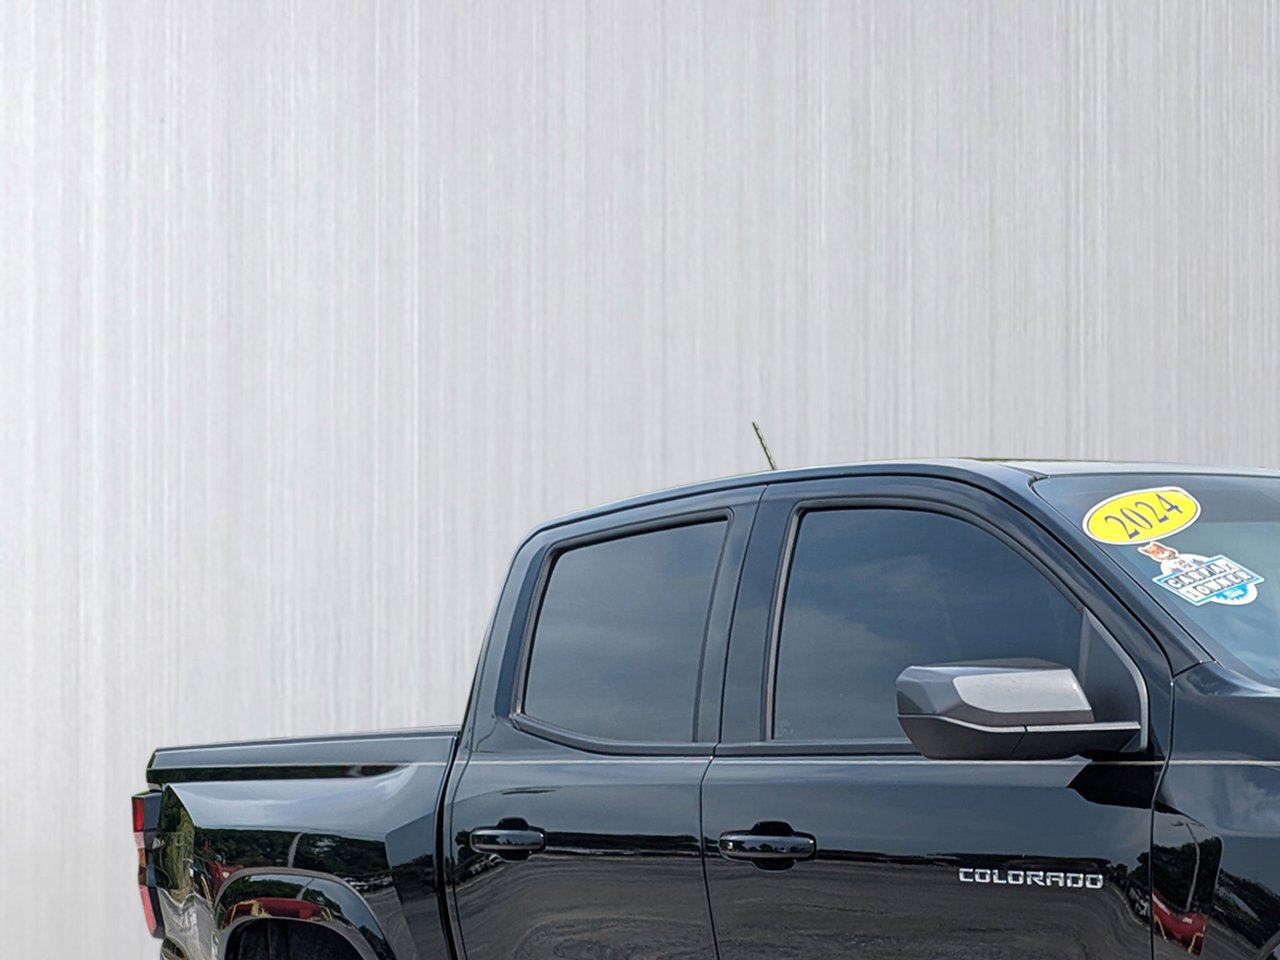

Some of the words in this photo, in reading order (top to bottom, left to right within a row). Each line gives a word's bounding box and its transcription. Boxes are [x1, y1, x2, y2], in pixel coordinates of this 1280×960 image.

[1104, 493, 1183, 540] 2024
[1166, 561, 1234, 590] CARFAX
[1193, 571, 1252, 596] OWNER
[958, 867, 1104, 889] COLORADO
